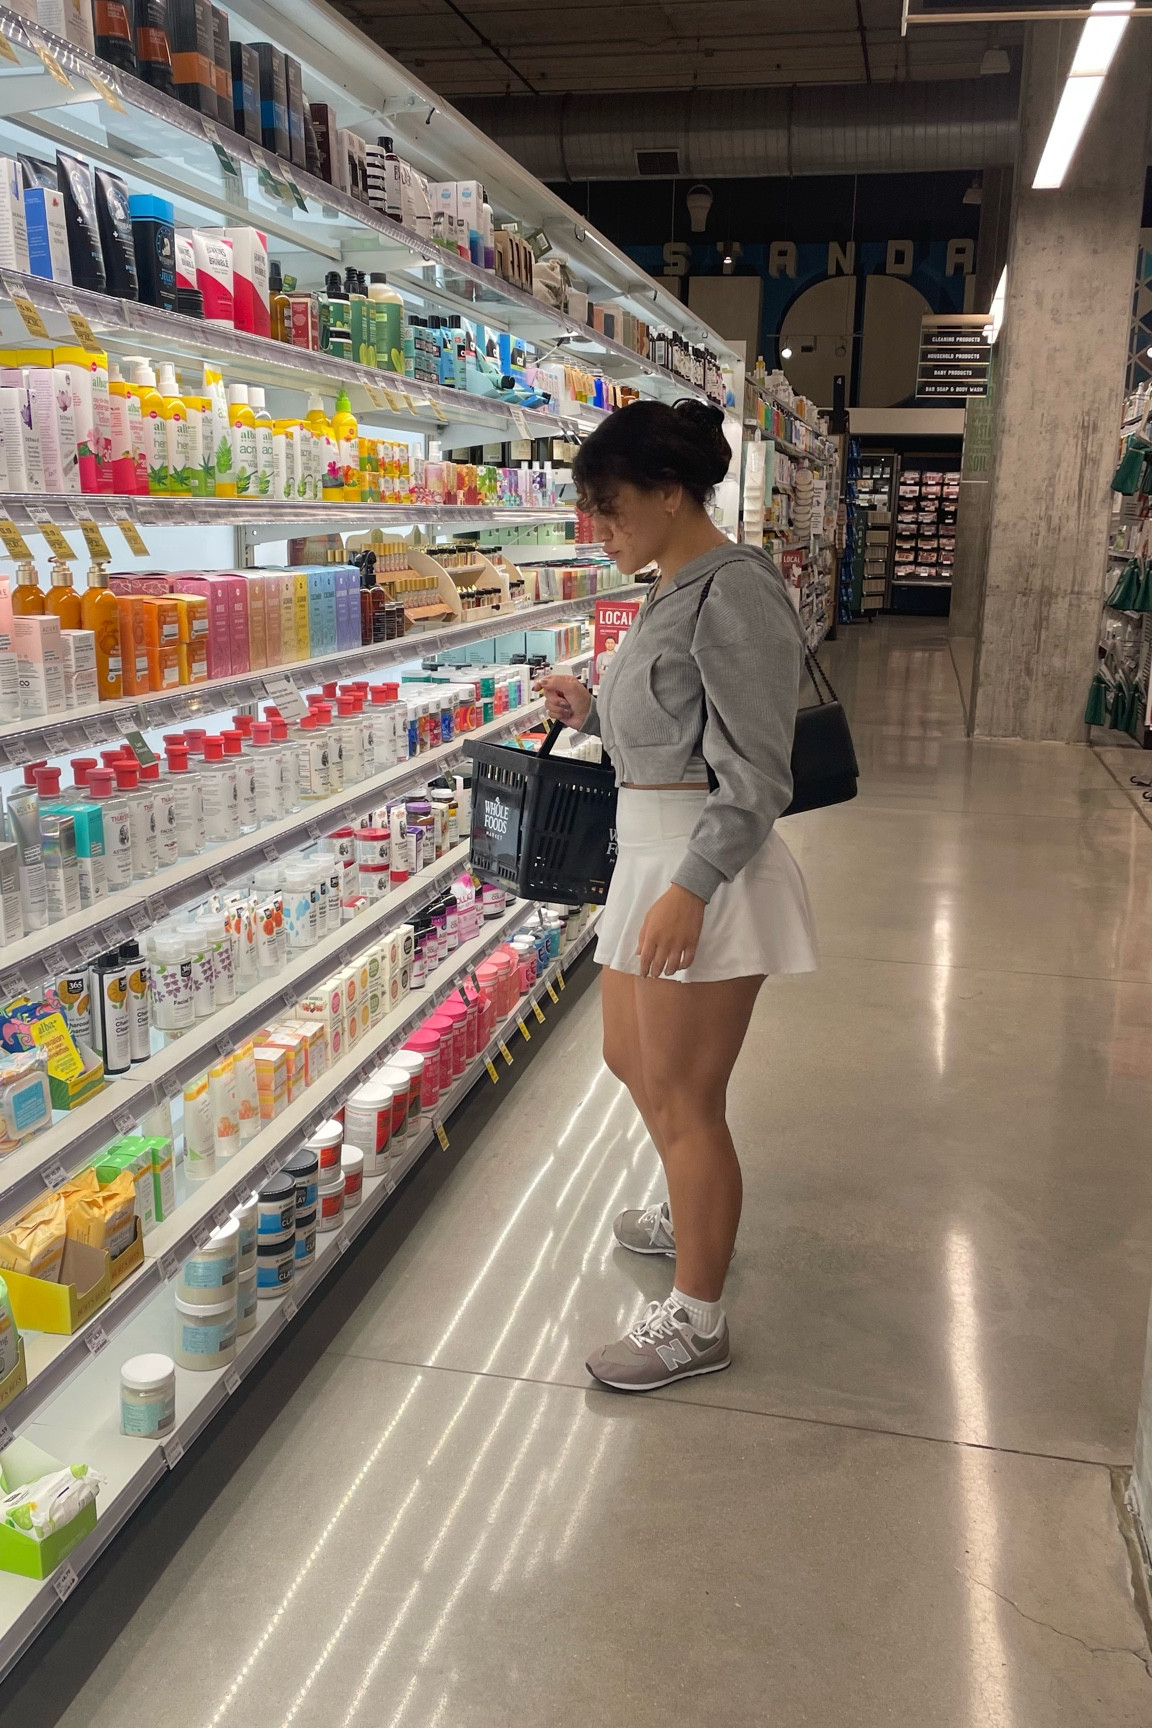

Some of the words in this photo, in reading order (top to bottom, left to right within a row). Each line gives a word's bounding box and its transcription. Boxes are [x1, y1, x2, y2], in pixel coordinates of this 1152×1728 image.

[783, 555, 801, 563] LOCAL
[599, 610, 633, 625] LOCAL
[484, 799, 510, 820] WHOLE
[484, 814, 508, 835] FOODS
[485, 831, 503, 840] MARKET
[68, 981, 83, 990] 365
[38, 1021, 54, 1035] alba
[656, 1338, 692, 1371] N
